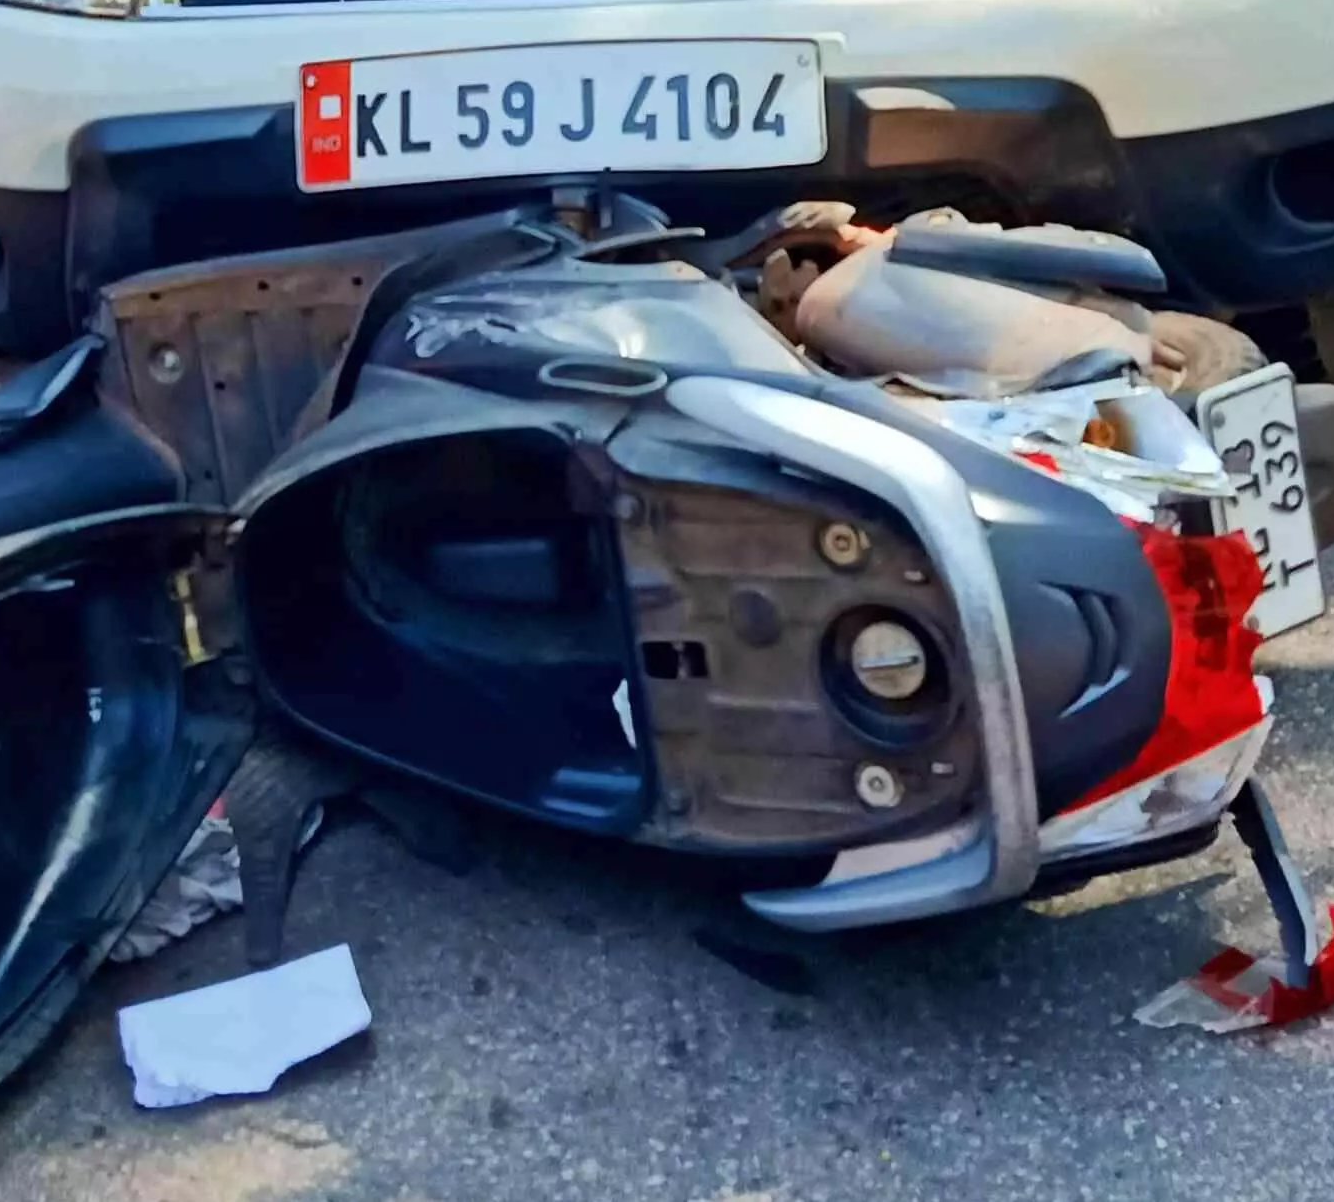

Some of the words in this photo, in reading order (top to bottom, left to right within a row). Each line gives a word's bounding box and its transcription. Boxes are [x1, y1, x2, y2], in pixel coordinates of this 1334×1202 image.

[355, 92, 432, 158] KL
[456, 80, 536, 148] 59
[559, 77, 595, 142] J
[620, 71, 786, 141] 4104
[1261, 420, 1305, 513] 639
